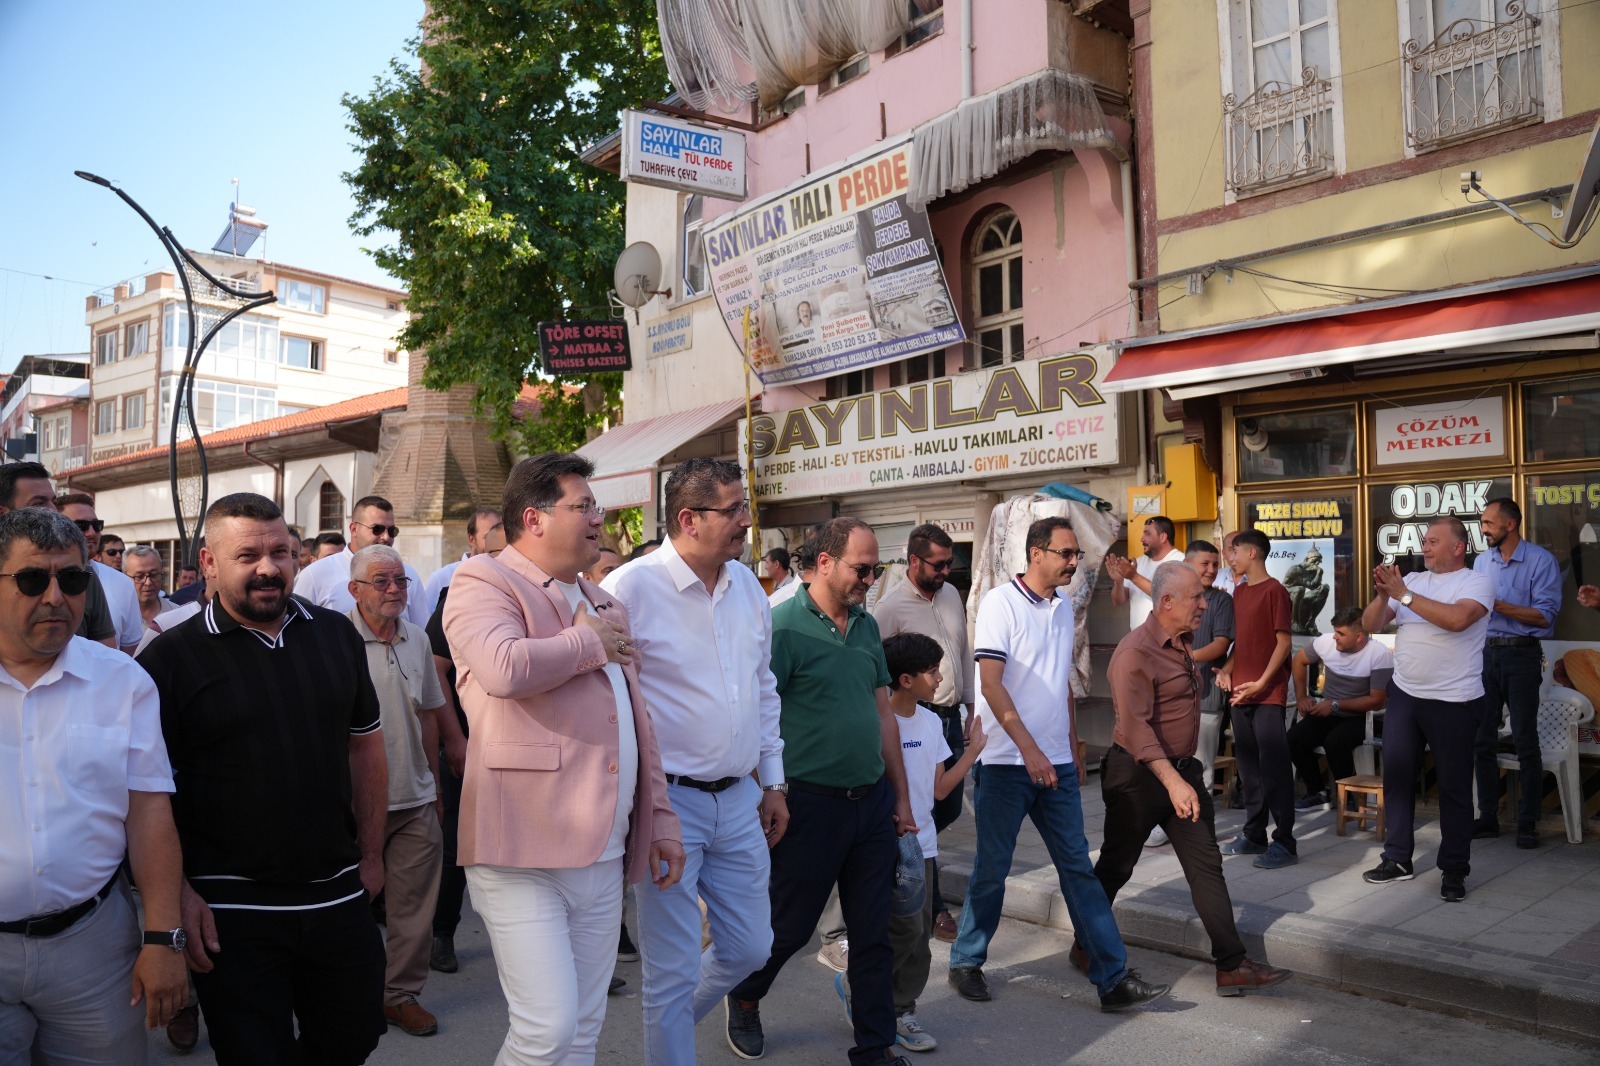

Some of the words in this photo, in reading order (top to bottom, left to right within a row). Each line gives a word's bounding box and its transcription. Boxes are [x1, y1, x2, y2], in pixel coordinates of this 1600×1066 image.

[642, 124, 721, 155] SAYINLAR
[640, 160, 676, 177] TUHAFİYE
[677, 167, 698, 182] ÇEYİZ
[685, 151, 701, 166] TÜL
[703, 156, 733, 171] PERDE
[708, 204, 788, 267] SAYINLAR
[790, 183, 833, 231] HALI
[838, 151, 909, 213] PERDE
[872, 201, 901, 226] HALIDA
[875, 220, 911, 248] PERDEDE
[866, 253, 885, 276] ŞOK
[884, 238, 930, 267] KAMPANYA
[545, 324, 581, 343] TÖRE
[583, 325, 624, 340] OFSET
[821, 322, 834, 332] Yeni
[836, 314, 867, 328] Şubemiz
[822, 331, 835, 340] Aras
[836, 325, 855, 336] Kargo
[564, 342, 612, 356] MATBAA
[783, 350, 809, 363] RAMAZAN
[807, 345, 822, 358] SAYIN
[832, 340, 843, 351] 553
[844, 336, 856, 348] 220
[857, 334, 866, 345] 52
[867, 331, 877, 342] 32
[744, 353, 1106, 459] SAYINLAR
[1396, 415, 1480, 437] ÇÖZÜM
[764, 460, 796, 478] PERDE
[803, 456, 827, 472] HALI
[834, 453, 849, 467] EV
[852, 444, 905, 465] TEKSTİLİ
[914, 437, 958, 457] HAVLU
[962, 424, 1043, 450] TAKIMLARI
[1055, 416, 1104, 441] ÇEYİZ
[1386, 428, 1492, 452] MERKEZİ
[869, 467, 904, 487] ÇANTA
[912, 460, 965, 478] AMBALAJ
[974, 454, 1009, 473] GİYİM
[1019, 443, 1098, 467] ZÜCCACİYE
[1391, 480, 1493, 519] ODAK
[1533, 484, 1586, 506] TOST
[1256, 503, 1291, 520] TAZE
[1292, 501, 1341, 519] SIKMA
[1253, 520, 1302, 537] MEYVE
[1302, 519, 1343, 536] SUYU
[902, 739, 922, 749] miav
